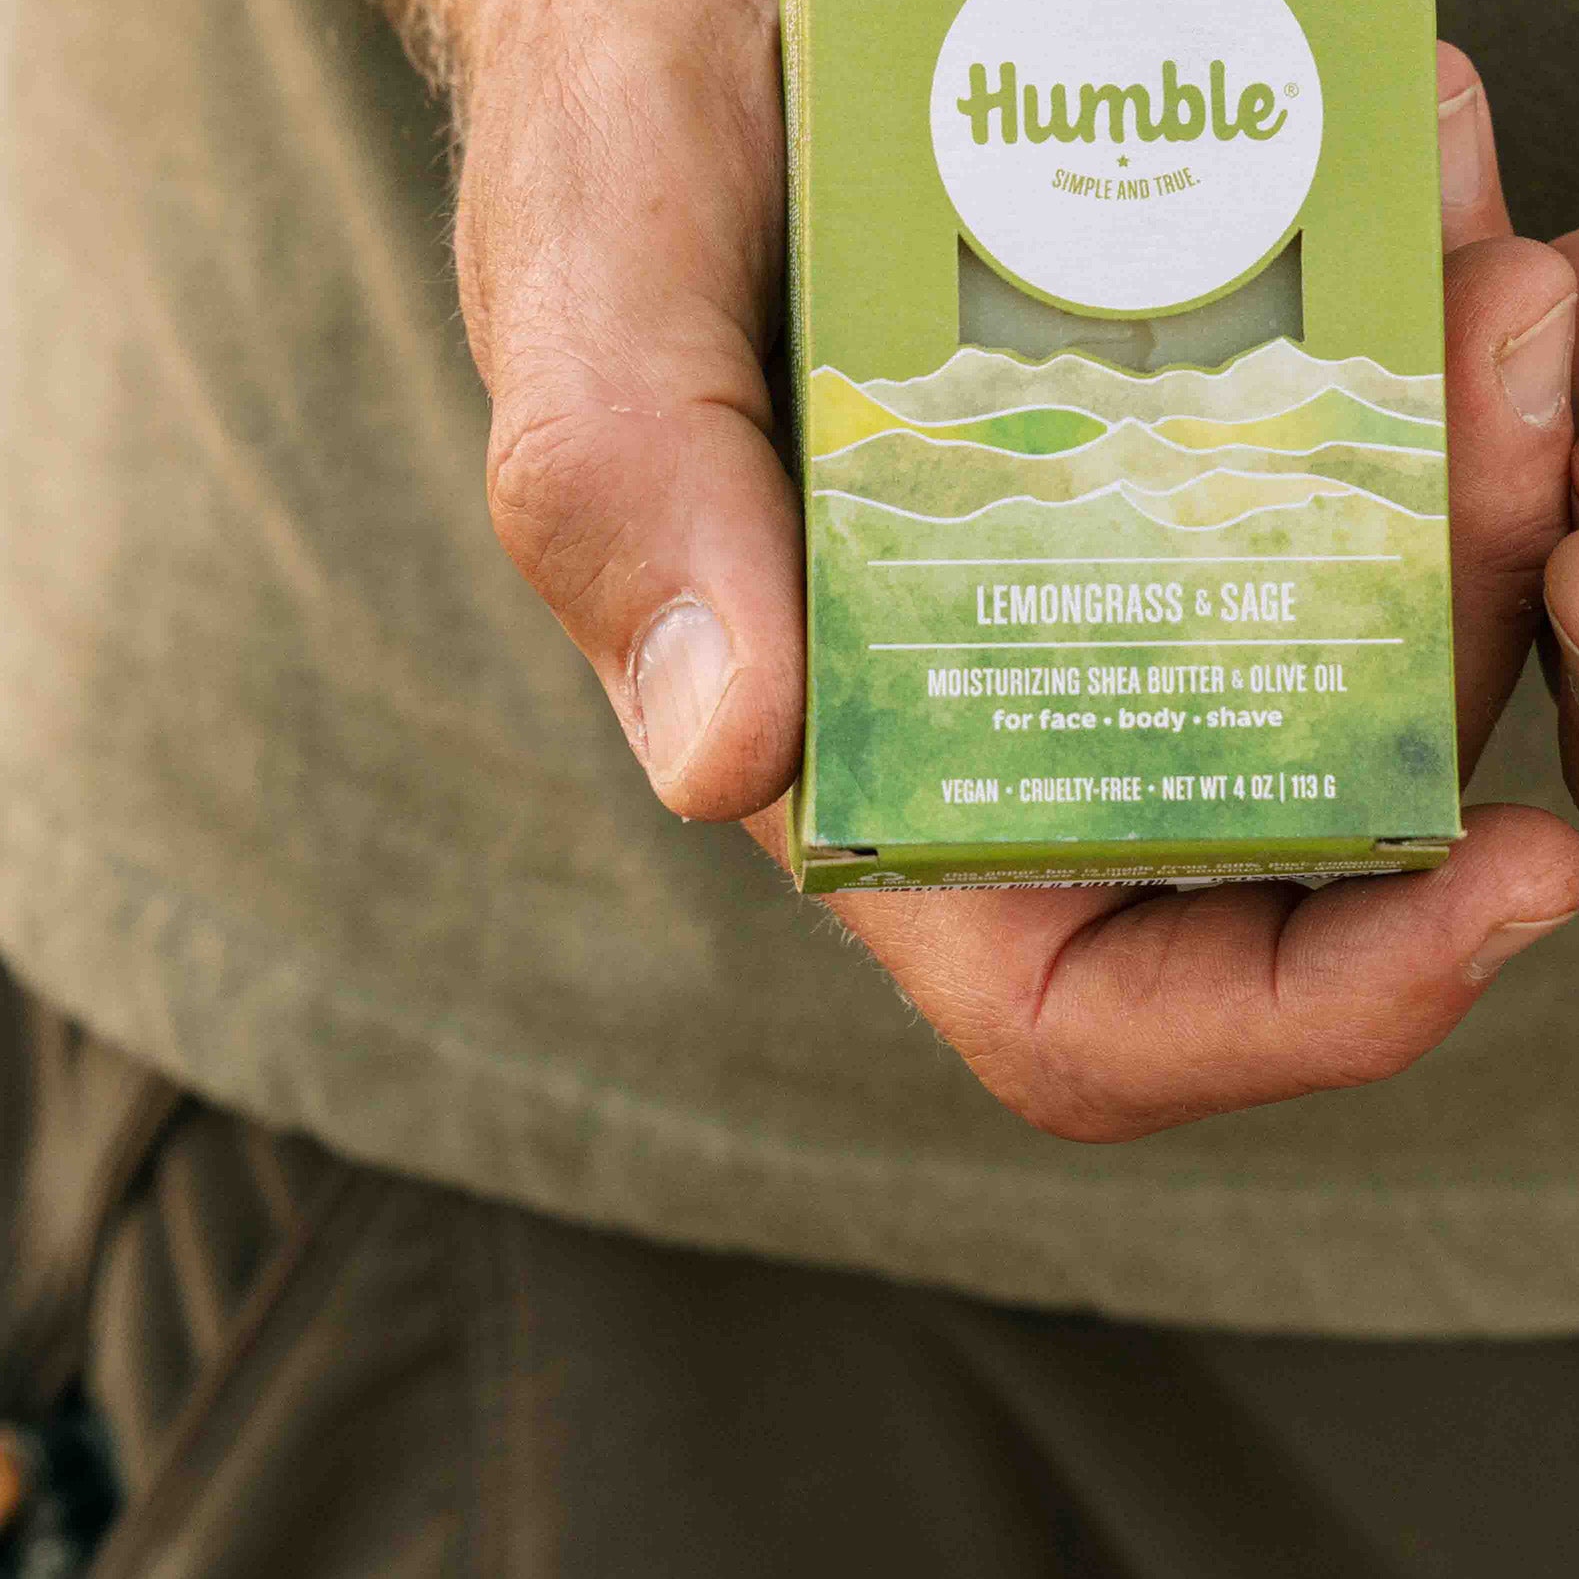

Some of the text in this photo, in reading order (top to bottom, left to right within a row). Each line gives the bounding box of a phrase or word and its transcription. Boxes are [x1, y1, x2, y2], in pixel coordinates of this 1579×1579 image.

[1051, 165, 1201, 200] SIMPLE AND TRUE.
[976, 582, 1296, 625] LEMONGRASS & SAGE
[927, 664, 1347, 697] MOISTURIZING SHEA BUTTER & OLIVE OIL
[993, 706, 1283, 732] for face body shave
[942, 779, 999, 803] VEGAN
[1019, 777, 1142, 802] CRUELTY-FREE
[1162, 776, 1195, 800] NET
[1199, 775, 1228, 800] WT
[1233, 775, 1245, 799] 4
[1251, 775, 1275, 799] OZ
[1291, 774, 1318, 798] 113
[1324, 774, 1336, 798] G
